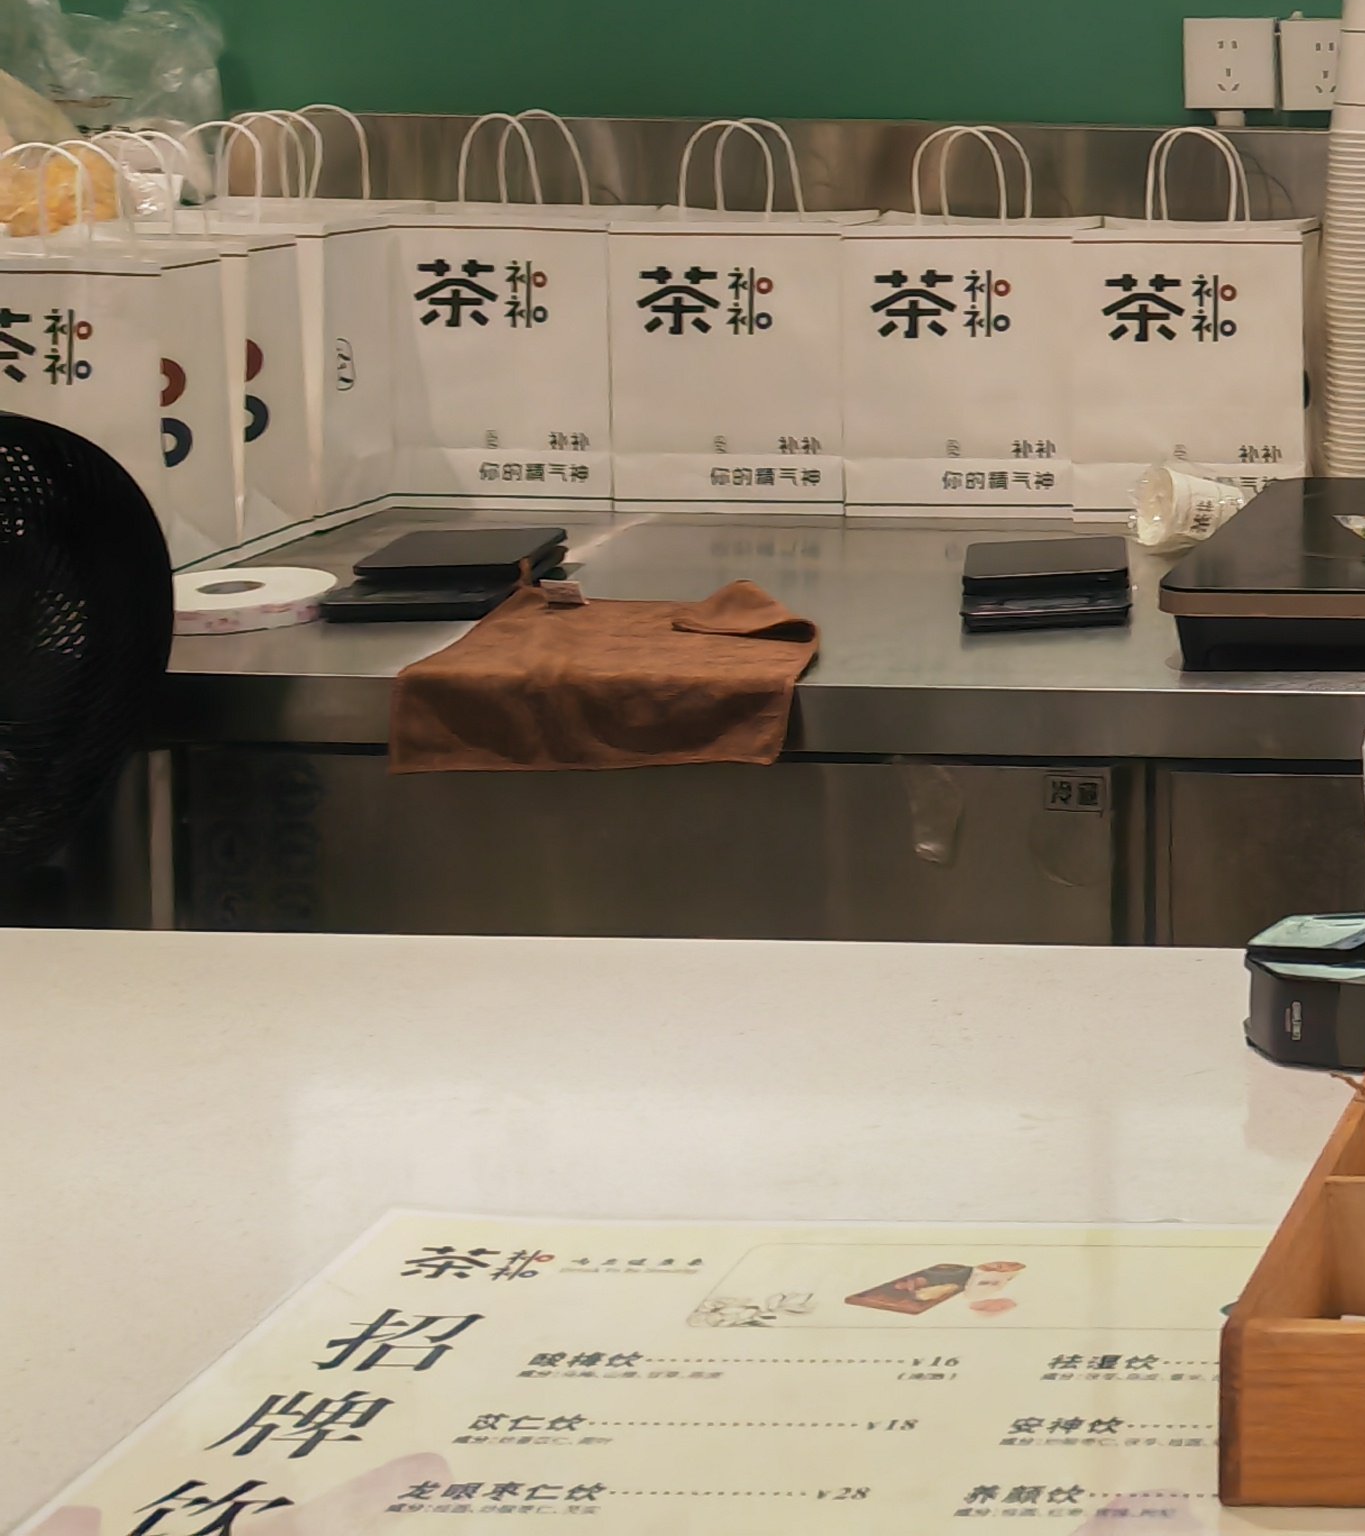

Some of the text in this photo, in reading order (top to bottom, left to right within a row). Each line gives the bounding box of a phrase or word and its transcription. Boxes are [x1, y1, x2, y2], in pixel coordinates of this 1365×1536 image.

[710, 467, 821, 487] 你的精气神
[941, 470, 1056, 491] 你的精气神
[1008, 1416, 1124, 1434] 安神饮
[397, 1480, 607, 1501] 龙眼枣仁饮
[964, 1483, 1085, 1504] 养颜饮
